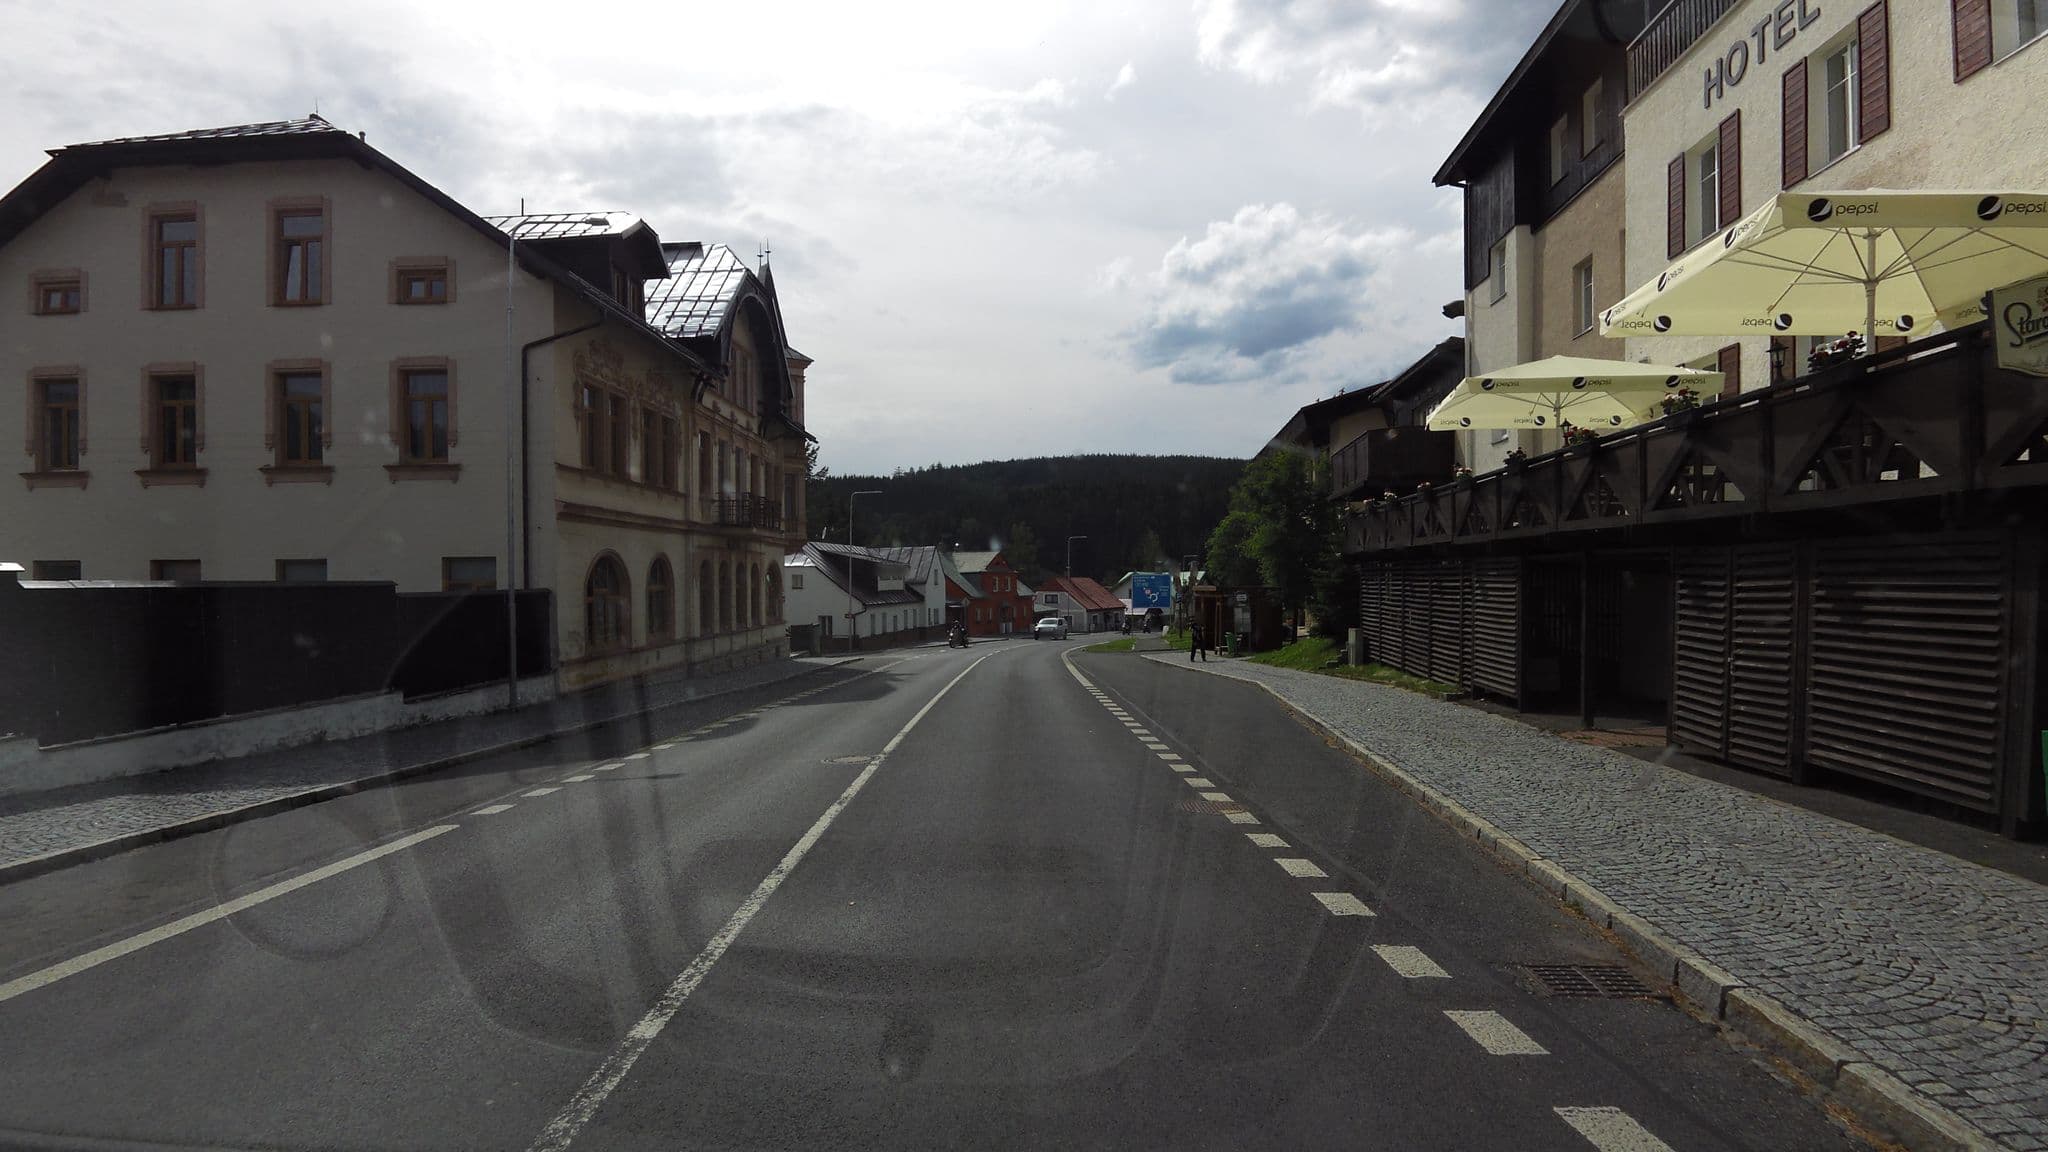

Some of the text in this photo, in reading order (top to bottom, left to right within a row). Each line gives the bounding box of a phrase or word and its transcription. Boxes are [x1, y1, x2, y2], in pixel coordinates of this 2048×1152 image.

[1704, 0, 1821, 109] HOTEL
[1836, 201, 1878, 216] pepsi
[1681, 377, 1706, 385] pepsi
